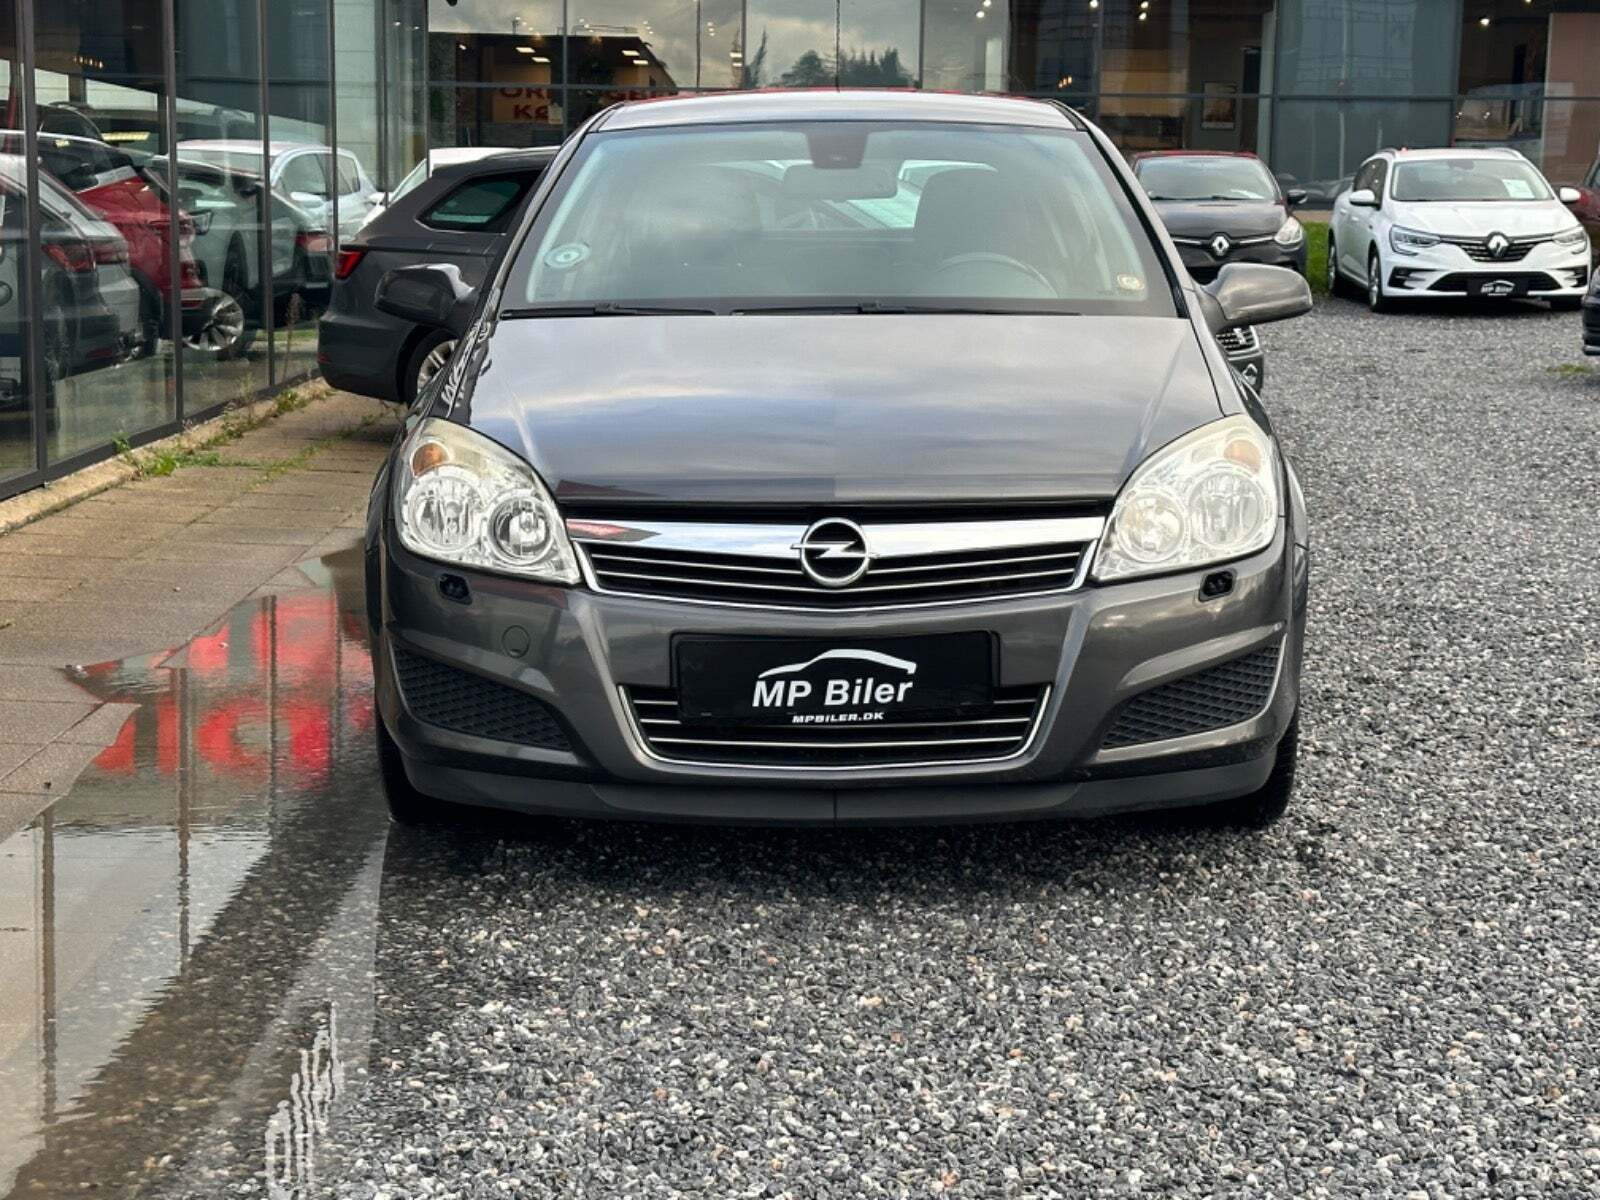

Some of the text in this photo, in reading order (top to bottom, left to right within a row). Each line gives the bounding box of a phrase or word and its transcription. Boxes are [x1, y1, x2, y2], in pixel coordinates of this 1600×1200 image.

[752, 677, 914, 707] MP Biler
[792, 712, 885, 723] MPBILER.DK
